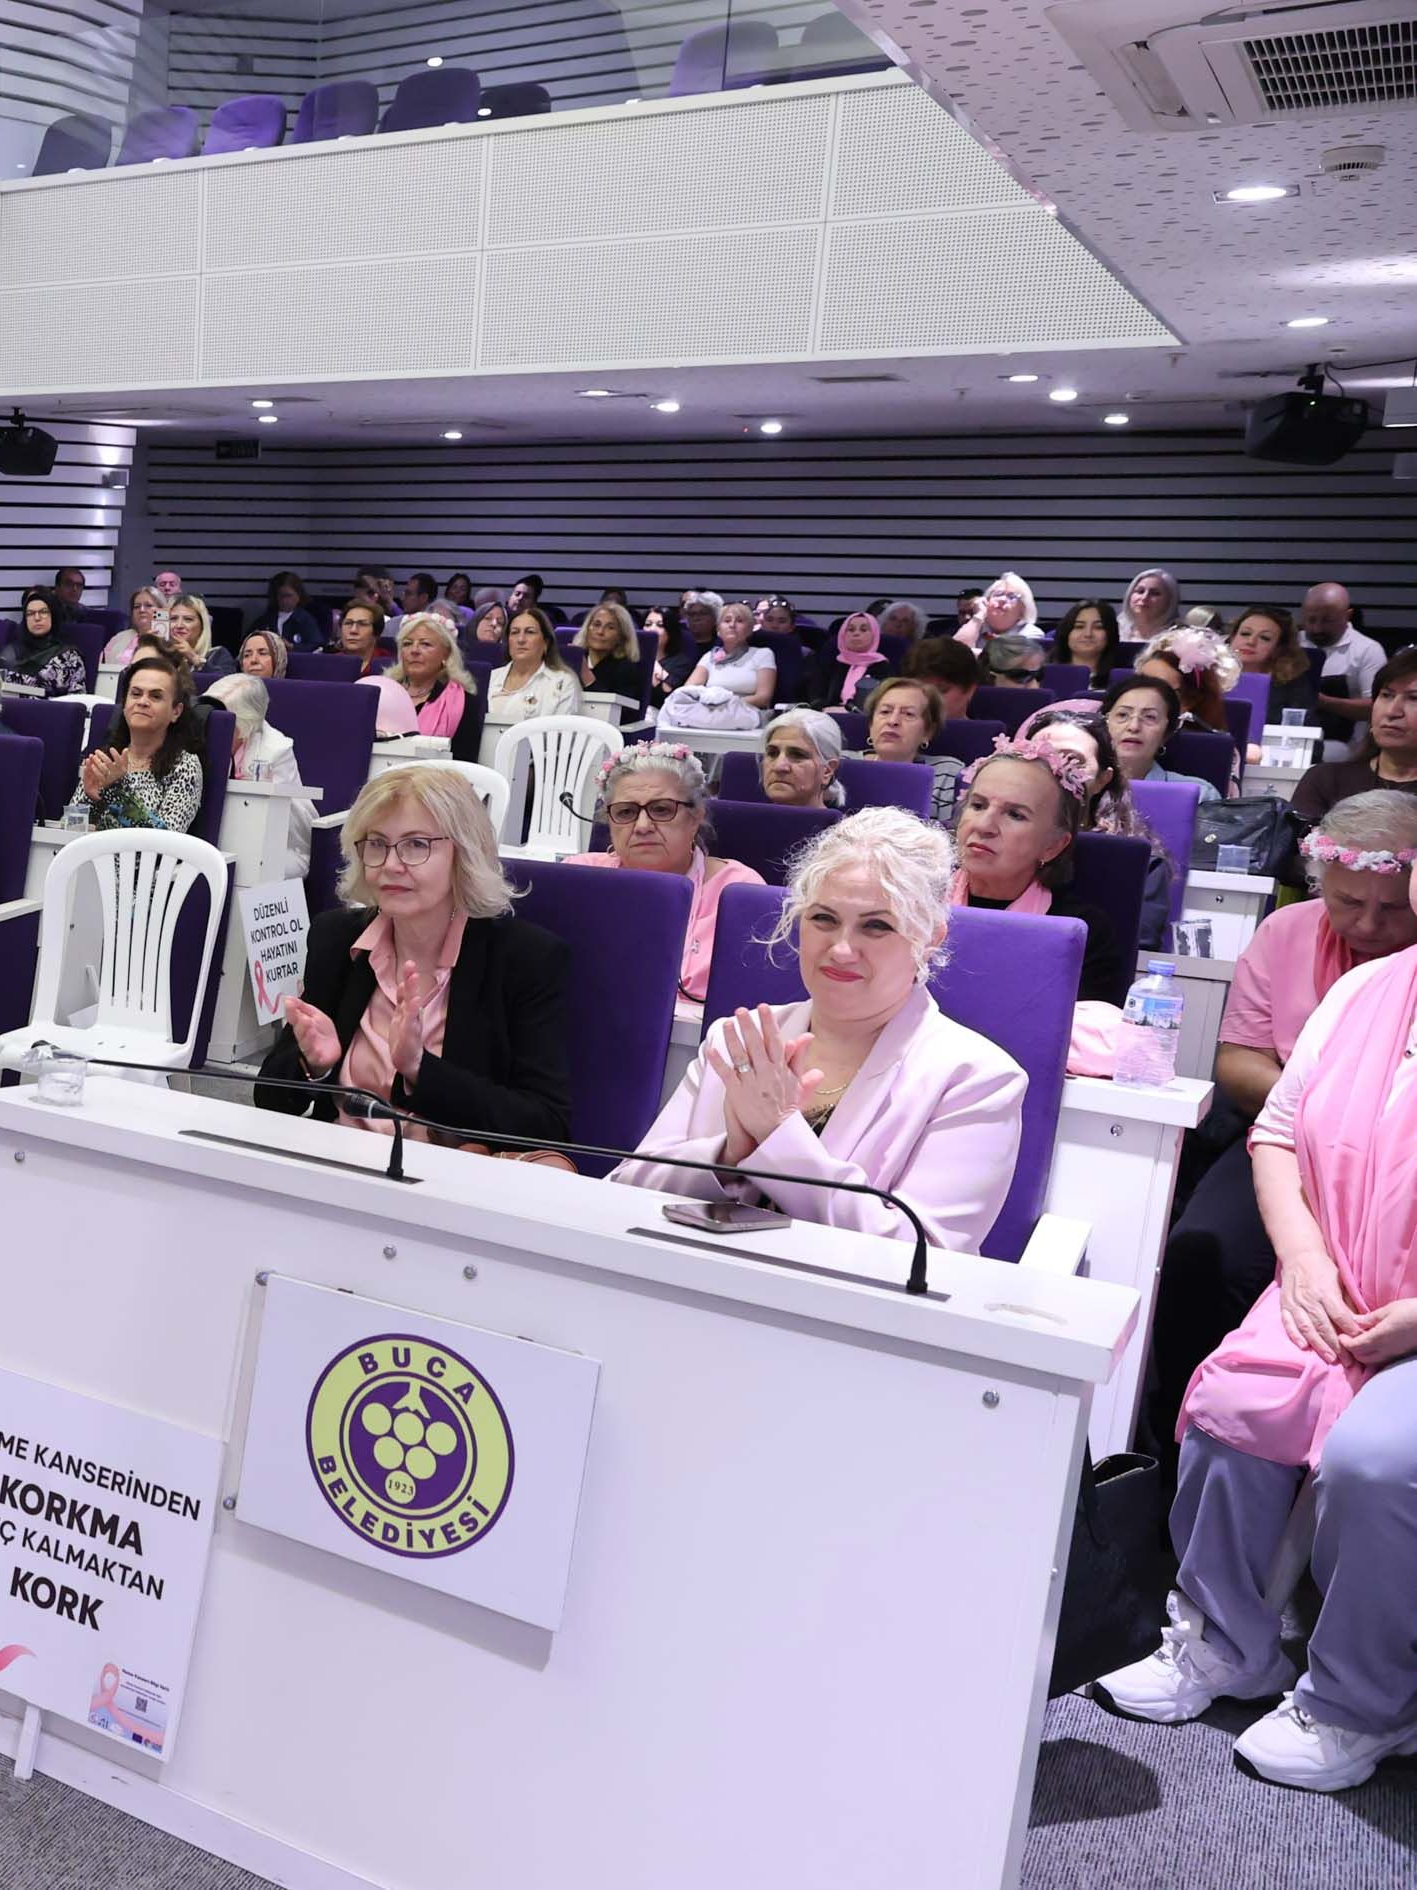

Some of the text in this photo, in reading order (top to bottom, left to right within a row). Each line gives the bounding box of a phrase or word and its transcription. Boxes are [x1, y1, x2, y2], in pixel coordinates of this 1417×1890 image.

[253, 897, 288, 921] DÜZENLİ
[250, 918, 304, 944] KONTROL OL
[260, 941, 298, 963] HAYATINI
[266, 962, 299, 983] KURTAR
[358, 1346, 476, 1405] BUCA
[34, 1444, 201, 1521] KANSERİNDEN
[317, 1455, 490, 1549] BELEDİYESİ
[388, 1480, 414, 1496] 1923
[22, 1527, 164, 1600] KALMAKTAN
[9, 1566, 105, 1631] KORK
